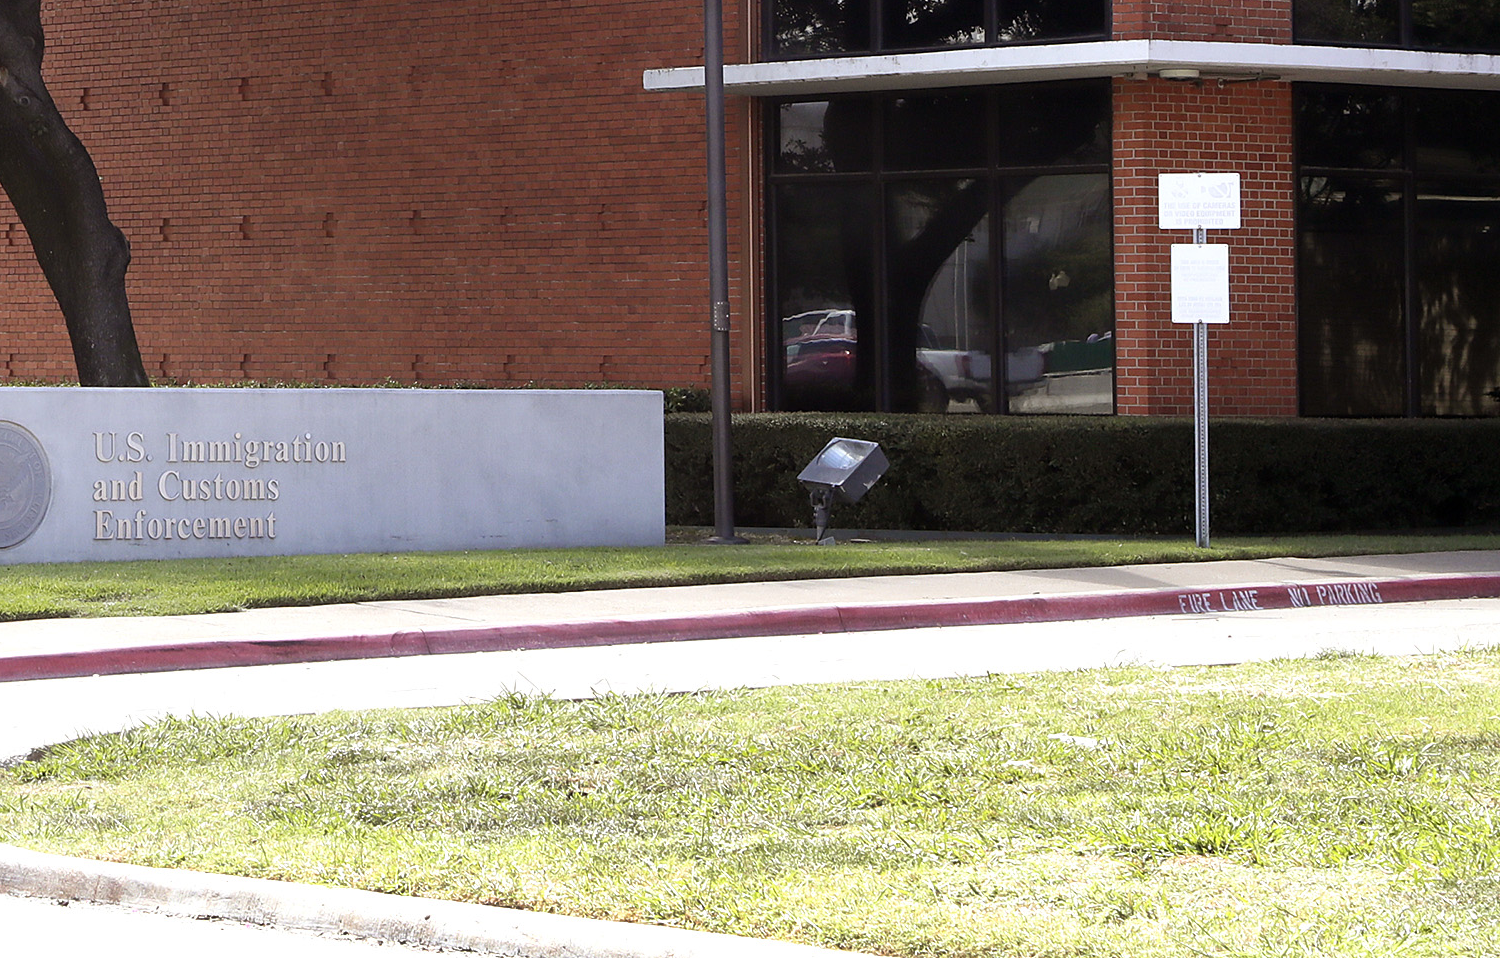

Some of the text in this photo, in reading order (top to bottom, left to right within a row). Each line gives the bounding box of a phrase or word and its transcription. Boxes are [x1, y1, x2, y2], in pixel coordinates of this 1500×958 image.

[93, 431, 346, 468] U.S. Immigration
[93, 470, 280, 502] and Customs
[93, 510, 277, 541] Enforcement
[1178, 592, 1217, 614] FIRE
[1219, 590, 1264, 612] LANE
[1316, 582, 1384, 605] PARKING
